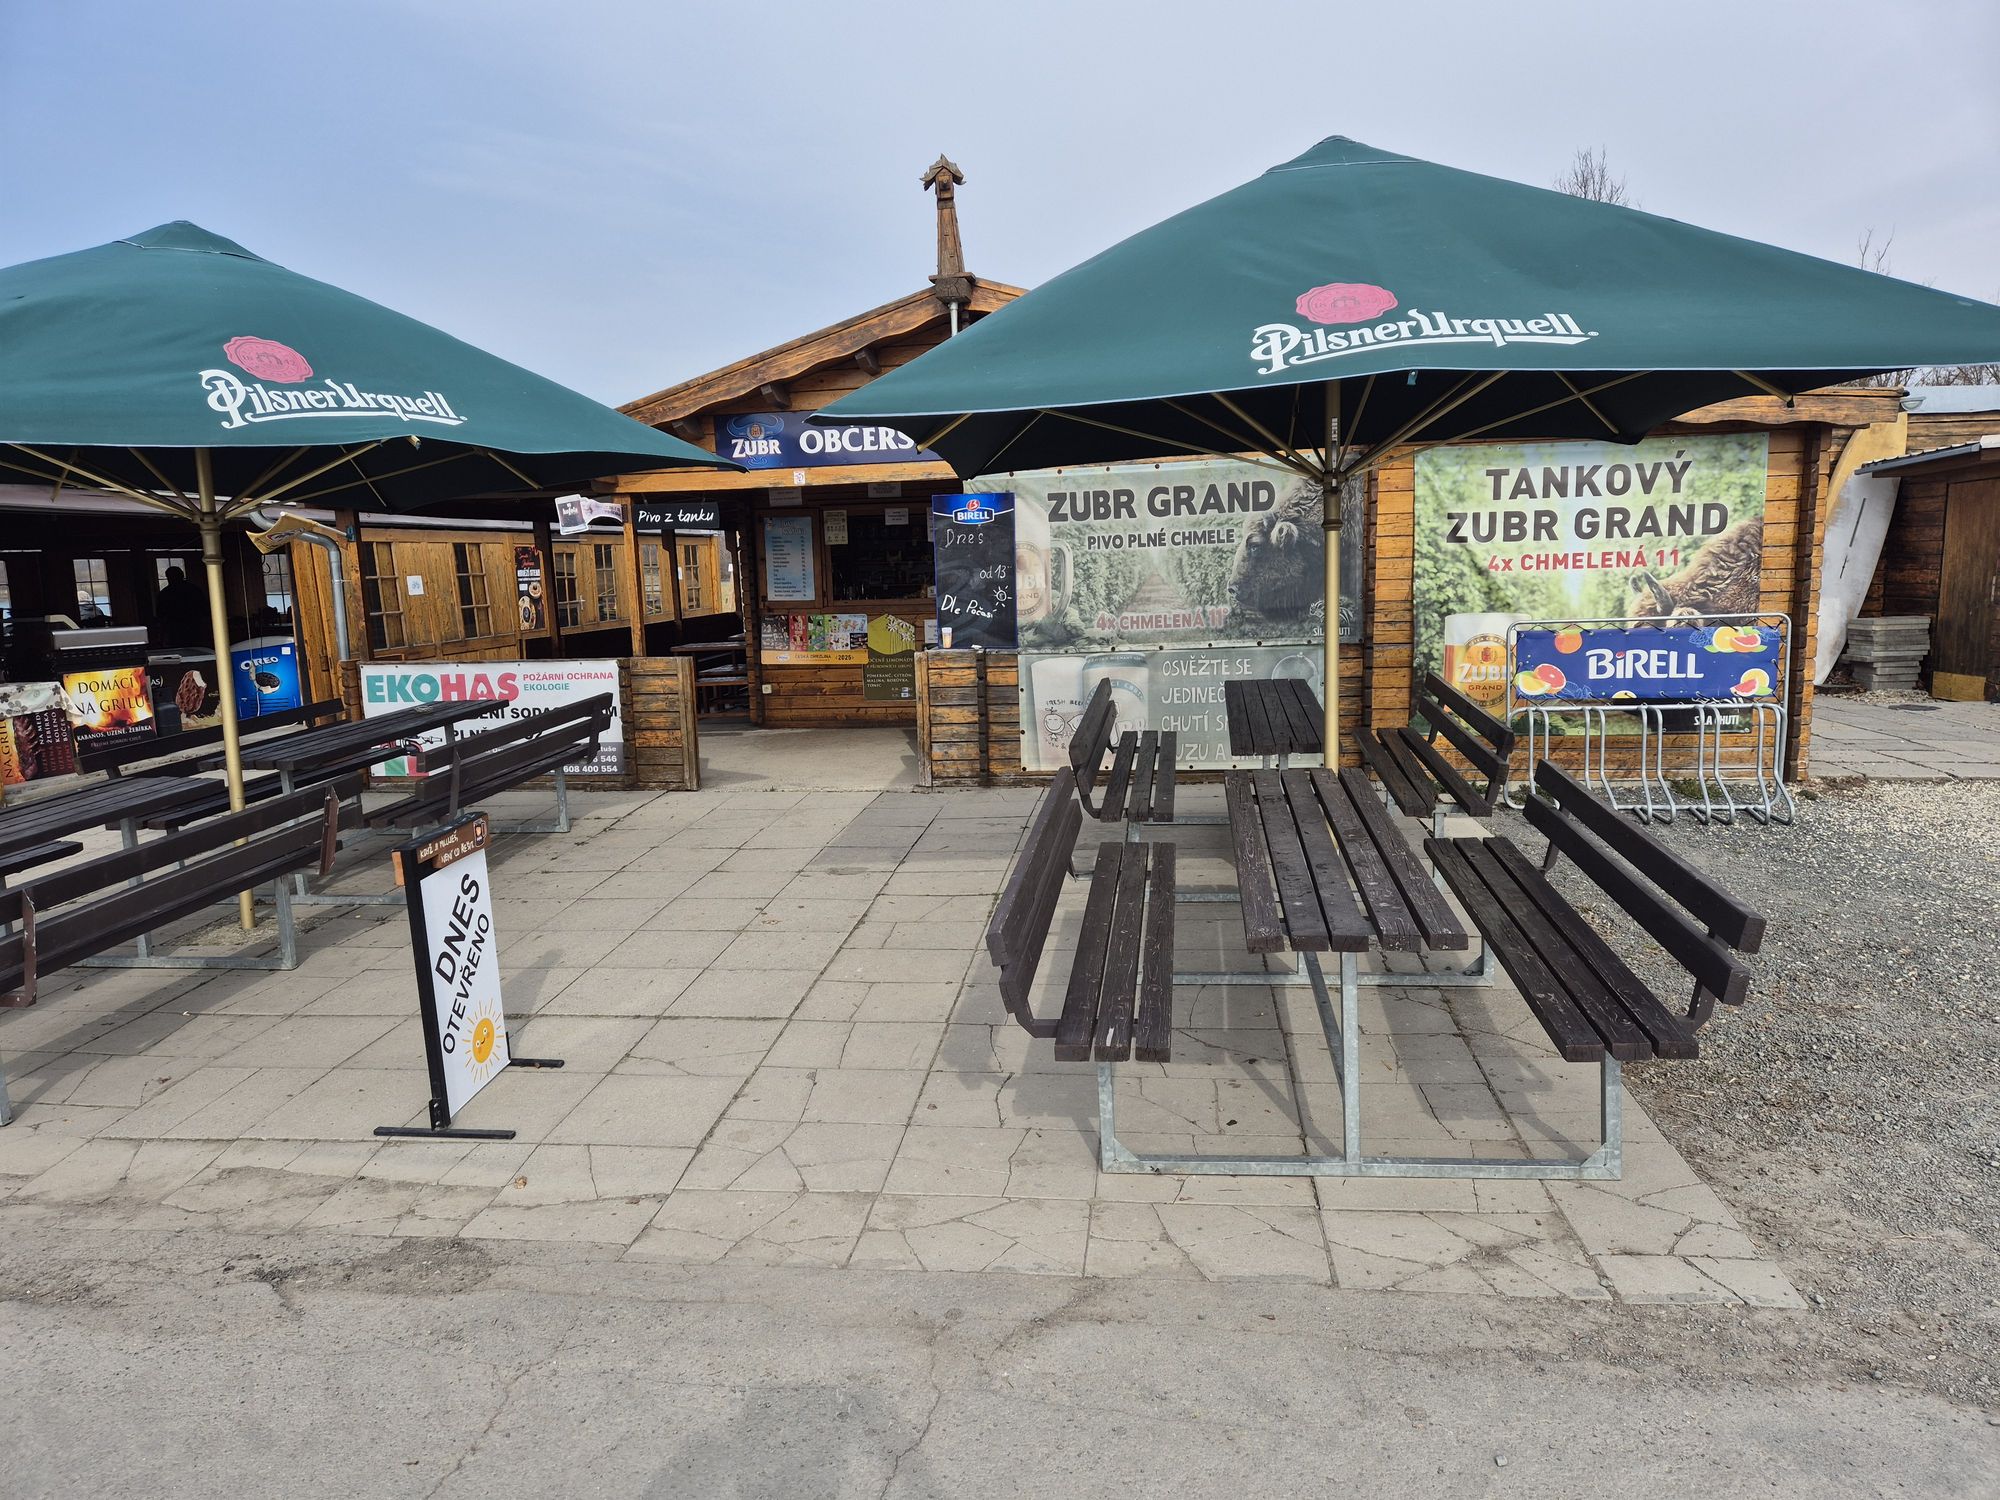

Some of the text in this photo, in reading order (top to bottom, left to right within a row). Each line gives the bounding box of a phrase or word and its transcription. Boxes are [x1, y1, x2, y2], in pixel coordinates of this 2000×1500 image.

[1250, 308, 1586, 375] Pilsner Urquell
[199, 369, 458, 429] Pilsner Urquell
[731, 439, 782, 458] ZUBR
[1485, 450, 1692, 500] TANKOVÝ
[1047, 480, 1276, 523] ZUBR GRAND
[638, 510, 661, 523] Pivo
[664, 513, 674, 523] z
[678, 509, 714, 522] tanku
[957, 511, 990, 520] BIRELL
[1446, 502, 1729, 543] ZUBR GRAND
[1087, 528, 1235, 550] PIVO PLNÉ CHMELE
[1488, 545, 1680, 572] 4x CHMELENÁ 11
[1096, 614, 1117, 631] 4x
[1119, 609, 1205, 631] CHMELENÁ
[240, 656, 279, 671] OREO
[1163, 655, 1230, 676] OSVĚŽTE
[1235, 658, 1252, 675] SE
[78, 673, 134, 694] DOMÁCÍ
[366, 671, 614, 703] EKOHAS POŽÁRNÍ OCHRANA
[523, 682, 570, 691] EKOLOGIE
[99, 696, 145, 713] GRILU
[35, 712, 43, 732] MED
[51, 711, 61, 743] KOLENO
[1162, 710, 1209, 731] CHUTÍ
[1715, 715, 1740, 725] HUTI
[1215, 743, 1226, 760] A
[3, 759, 14, 778] NA
[563, 765, 581, 773] 608
[582, 765, 599, 773] 400
[600, 764, 618, 773] 554
[435, 873, 480, 984] DNES
[442, 913, 490, 1054] OTEVŘENO
